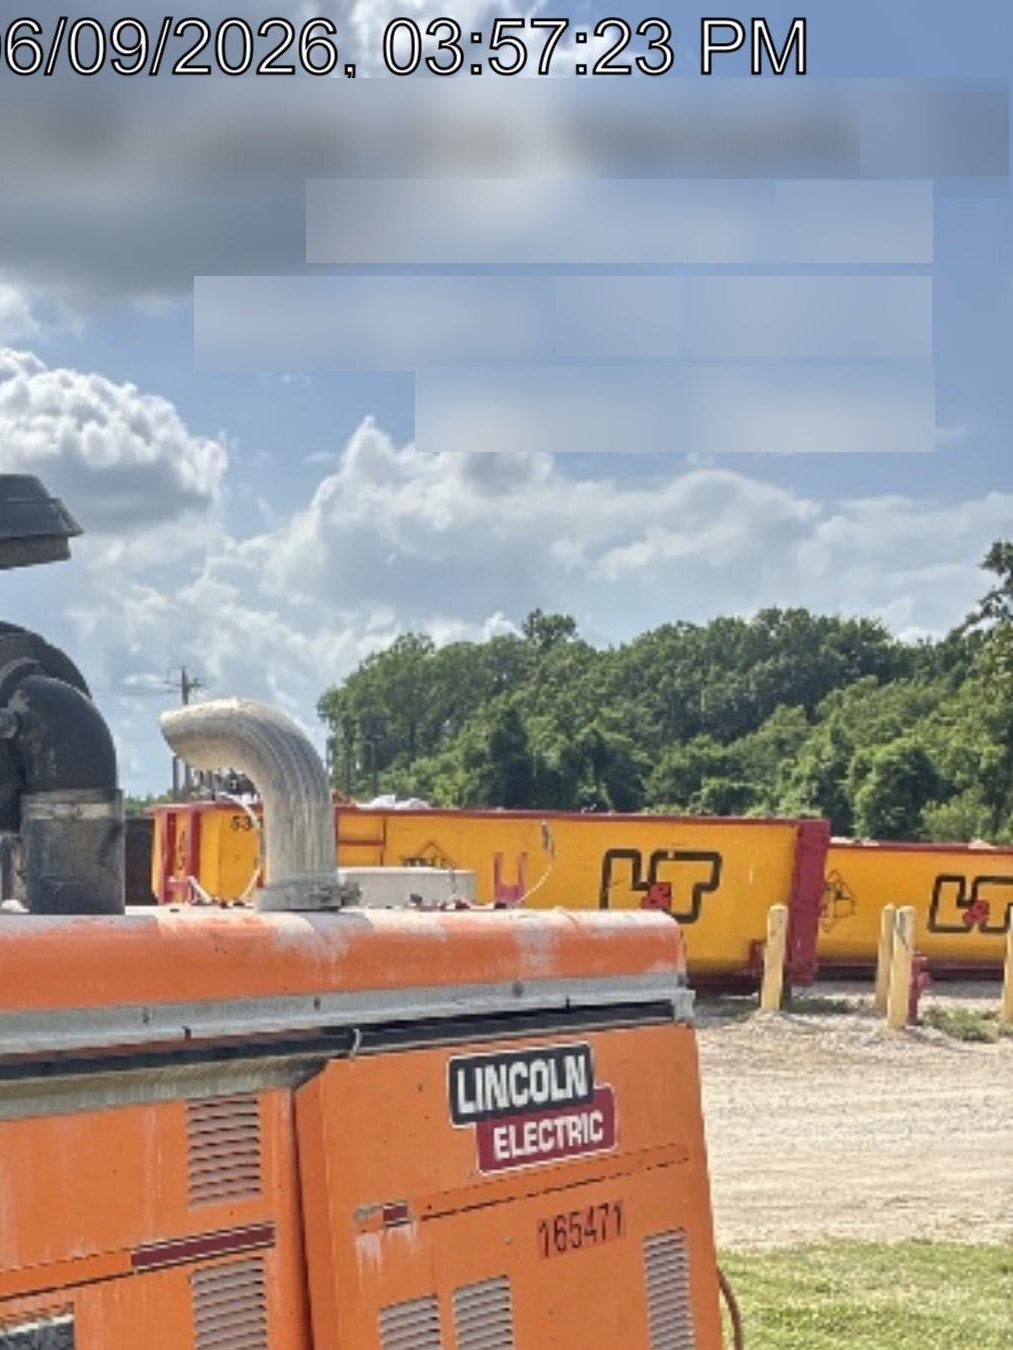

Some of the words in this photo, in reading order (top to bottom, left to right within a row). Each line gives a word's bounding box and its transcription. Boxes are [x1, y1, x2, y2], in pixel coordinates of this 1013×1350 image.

[456, 1055, 588, 1114] LINCOLN
[493, 1110, 604, 1160] ELECTRIC
[539, 1202, 623, 1258] 165471
